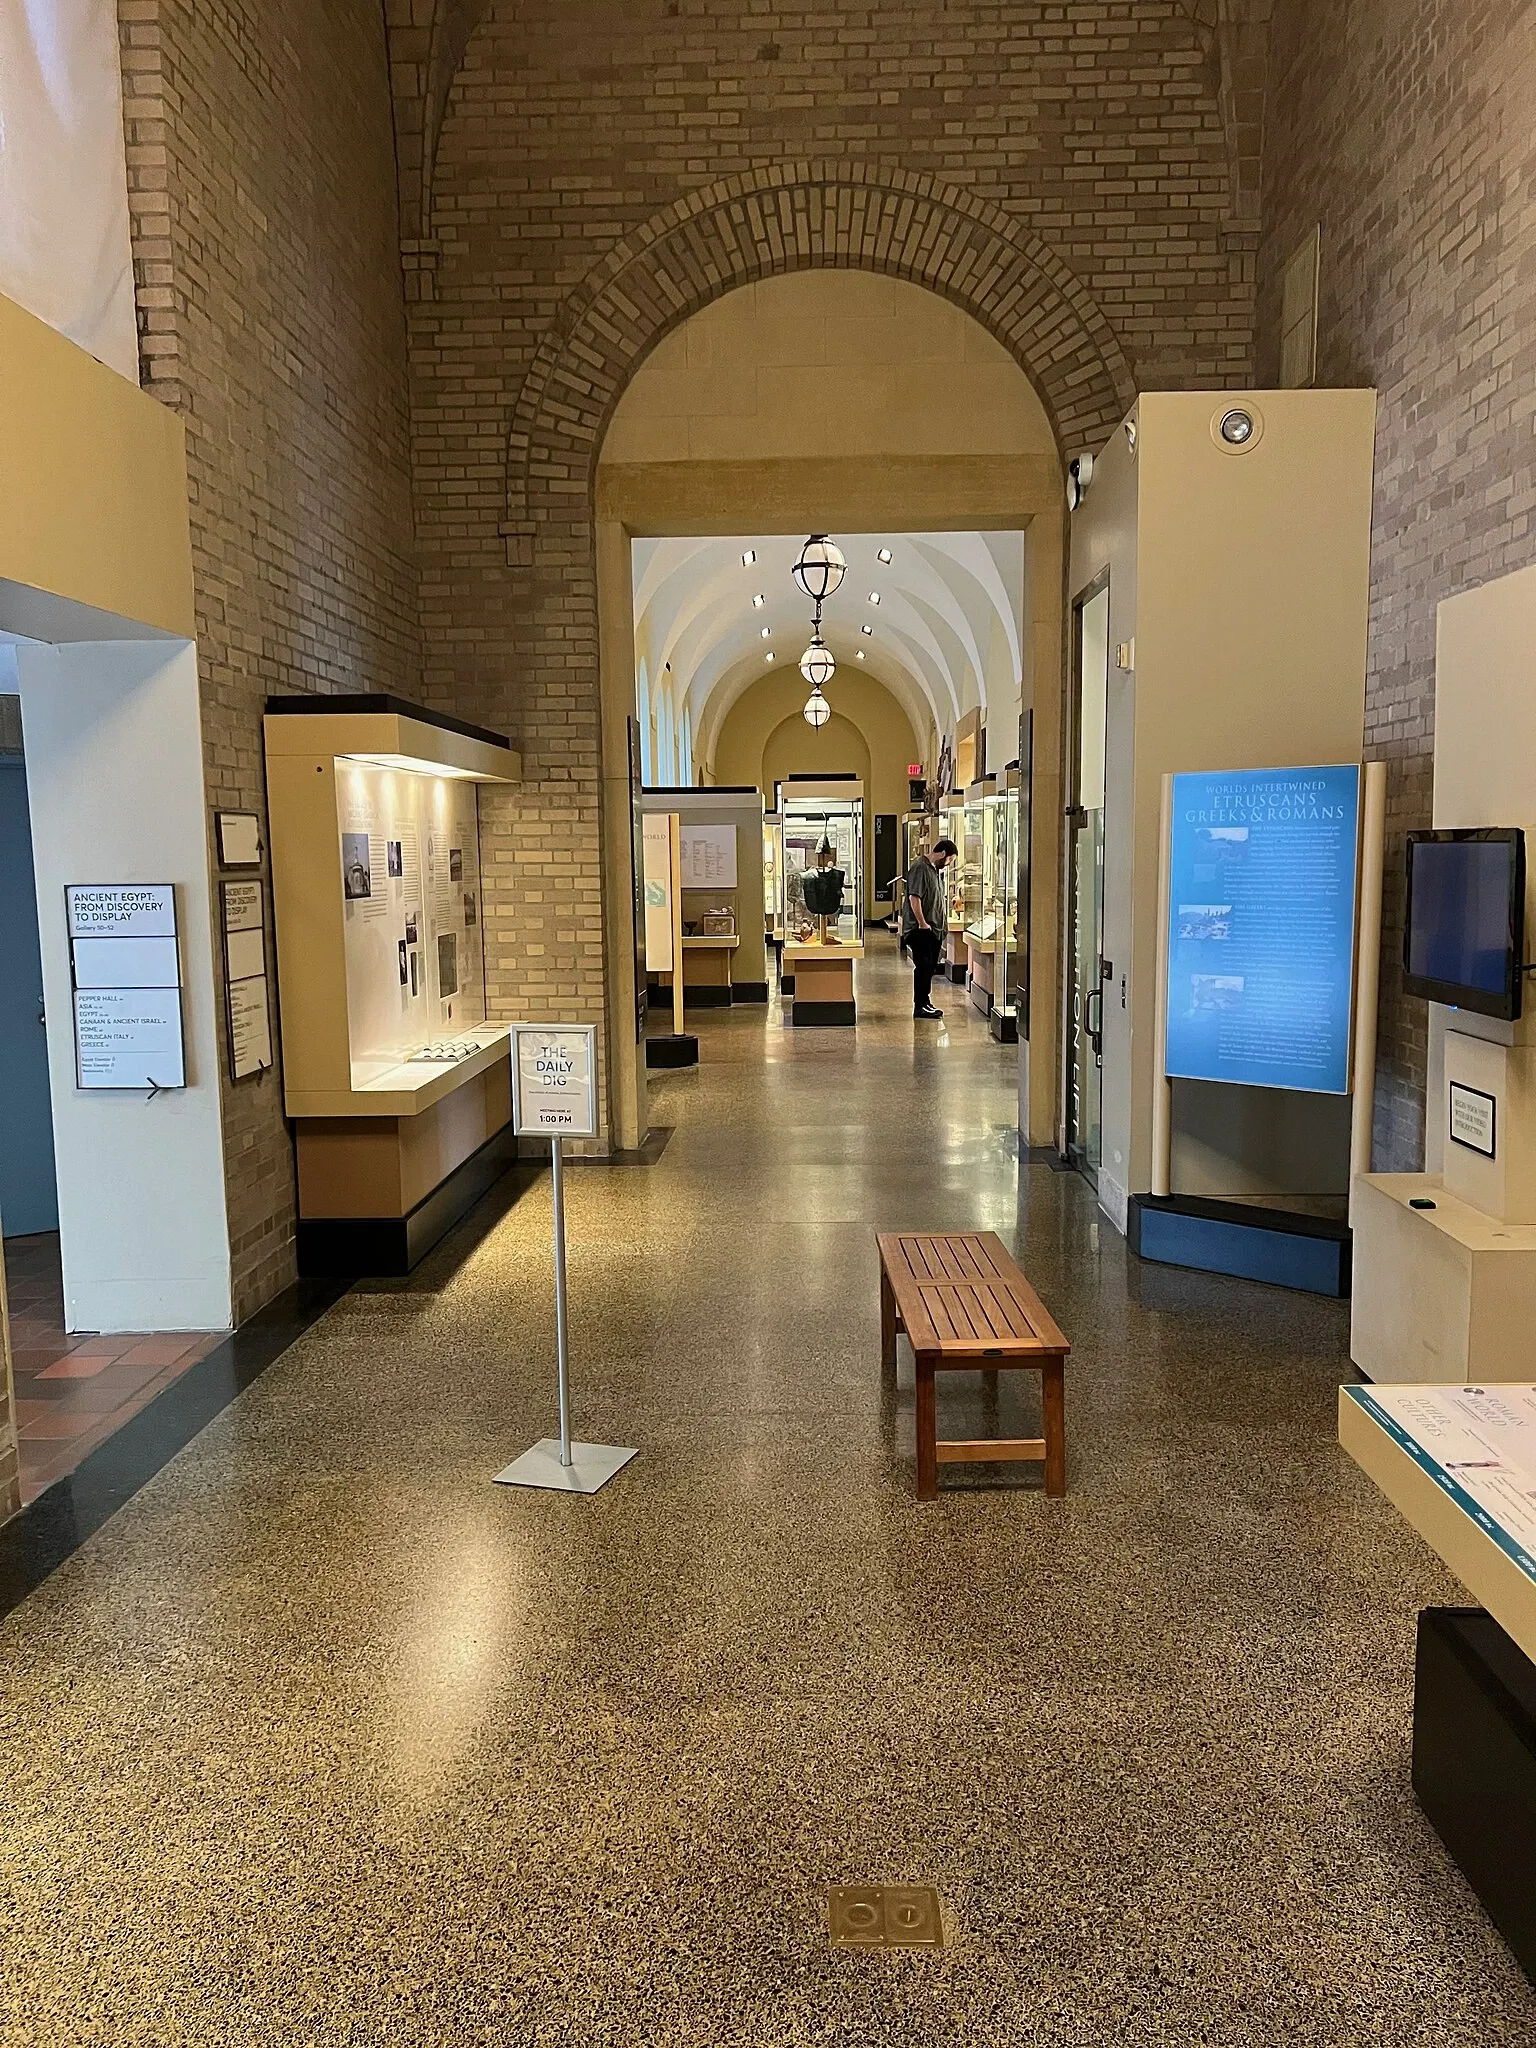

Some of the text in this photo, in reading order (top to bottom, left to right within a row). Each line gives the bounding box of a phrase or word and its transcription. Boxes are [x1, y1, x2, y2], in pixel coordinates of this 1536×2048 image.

[1206, 782, 1326, 794] WORLDS INTERTWINED
[1214, 792, 1316, 809] ETRUSCANS
[1186, 806, 1344, 823] GREEKS & ROMANS
[74, 892, 155, 901] ANCIENT EGYPT:
[74, 902, 163, 911] FROM DISCOVERY
[75, 912, 132, 921] TO DISPLAY
[1072, 843, 1082, 1136] EXHIBITION LIFT
[541, 1046, 566, 1058] THE
[536, 1061, 573, 1072] DAILY
[543, 1075, 567, 1086] DIG
[1397, 1399, 1446, 1437] CULTURES
[1416, 1399, 1452, 1425] OTHER
[1467, 1398, 1508, 1426] WORLD
[1485, 1398, 1529, 1427] ROMAN
